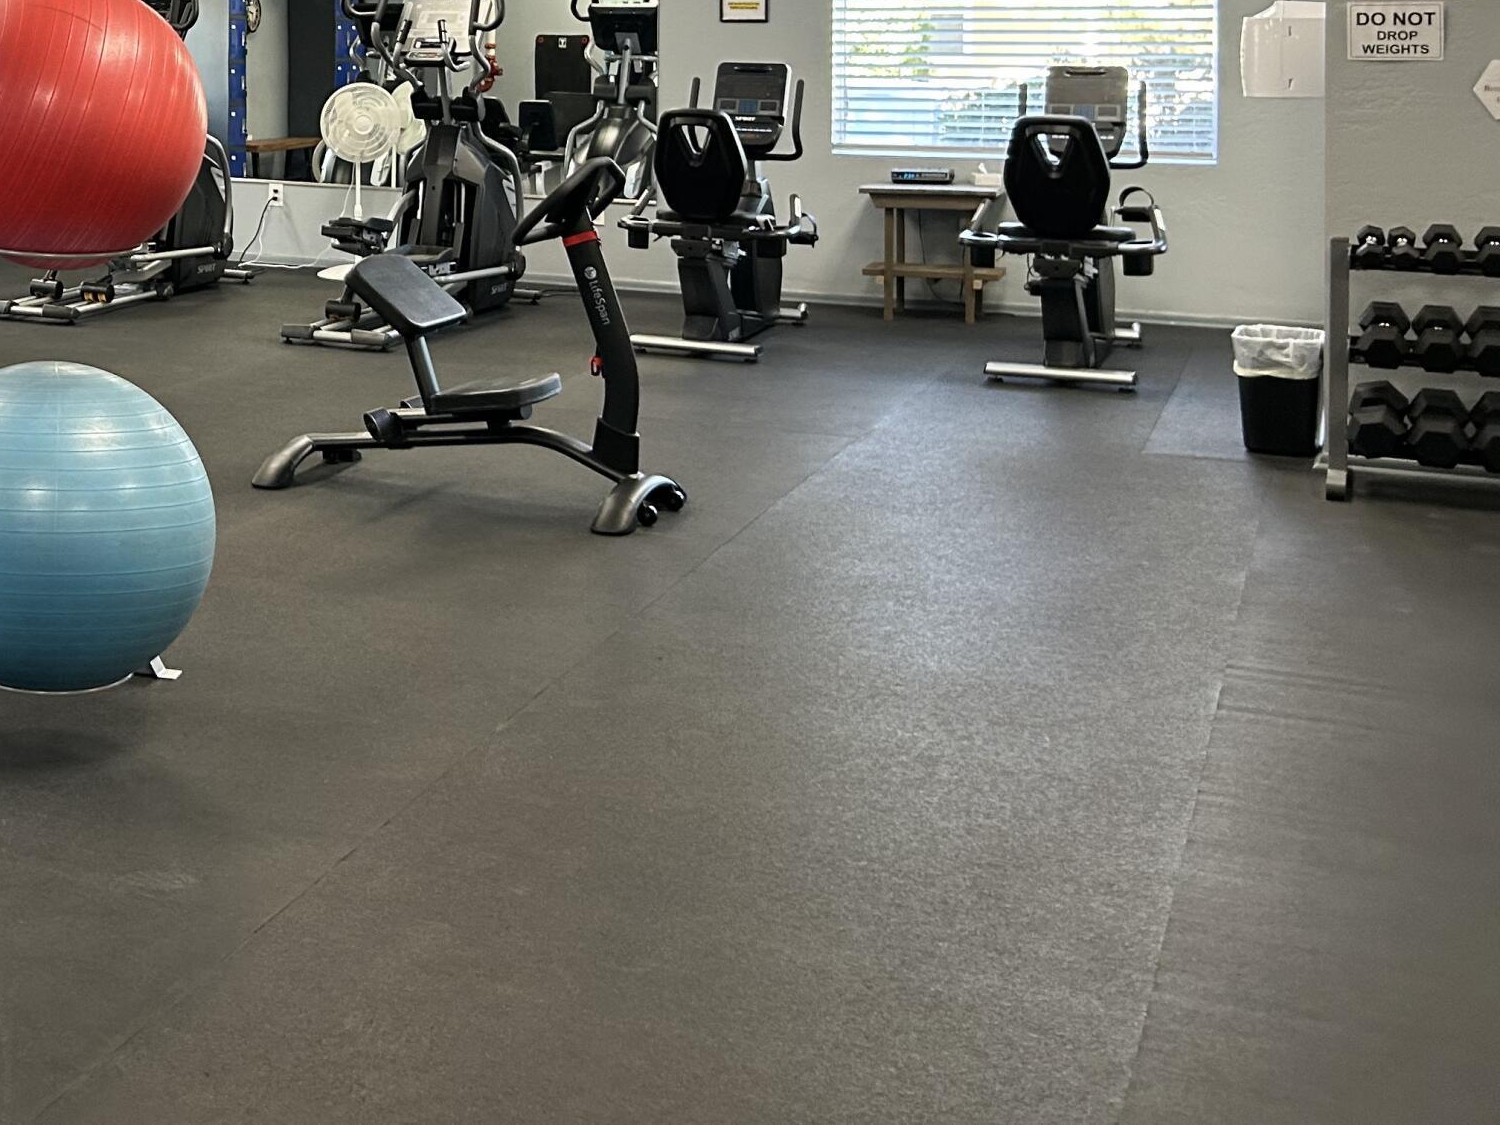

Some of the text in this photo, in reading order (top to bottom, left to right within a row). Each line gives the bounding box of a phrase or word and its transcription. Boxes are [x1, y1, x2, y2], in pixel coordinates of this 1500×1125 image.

[1356, 11, 1436, 26] DO NOT
[1377, 30, 1418, 41] DROP
[1362, 44, 1430, 55] WEIGHTS
[589, 279, 610, 325] LifeSpan
